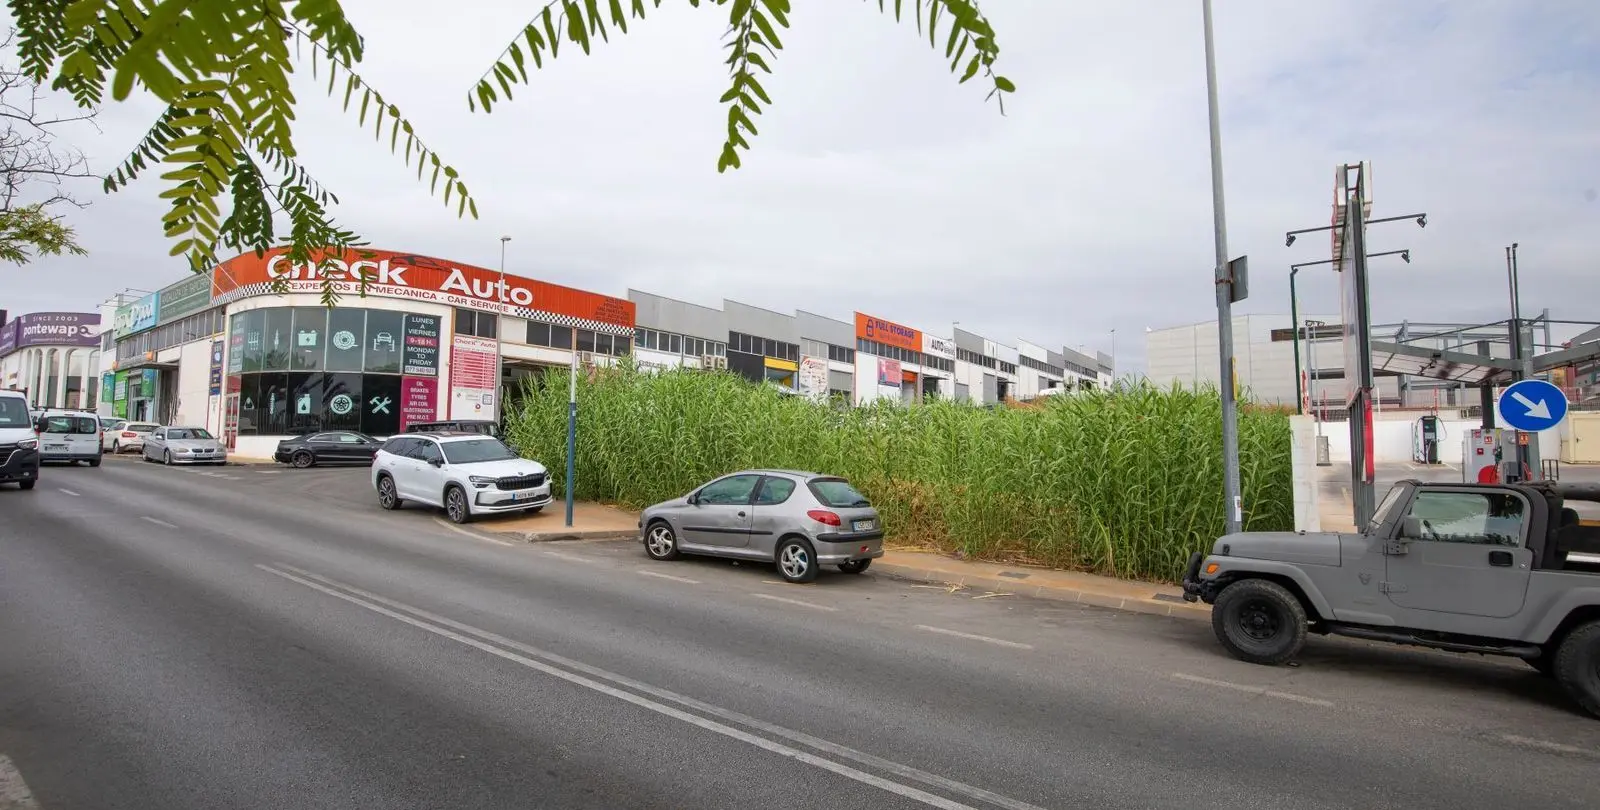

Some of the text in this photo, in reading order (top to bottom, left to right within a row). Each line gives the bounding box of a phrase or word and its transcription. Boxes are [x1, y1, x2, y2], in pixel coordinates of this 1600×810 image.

[266, 254, 534, 306] Check Auto
[291, 281, 351, 291] EXPEOS
[376, 287, 437, 301] MECANICA
[447, 295, 468, 306] CAR
[470, 299, 509, 313] SERVICE
[412, 317, 434, 325] LUNES
[23, 323, 79, 338] pontewap
[408, 328, 437, 337] VIERNES
[875, 320, 915, 339] FULL STORAGE
[407, 346, 436, 354] MONDAY
[931, 339, 944, 352] AUTO
[409, 358, 433, 366] FRIDAY
